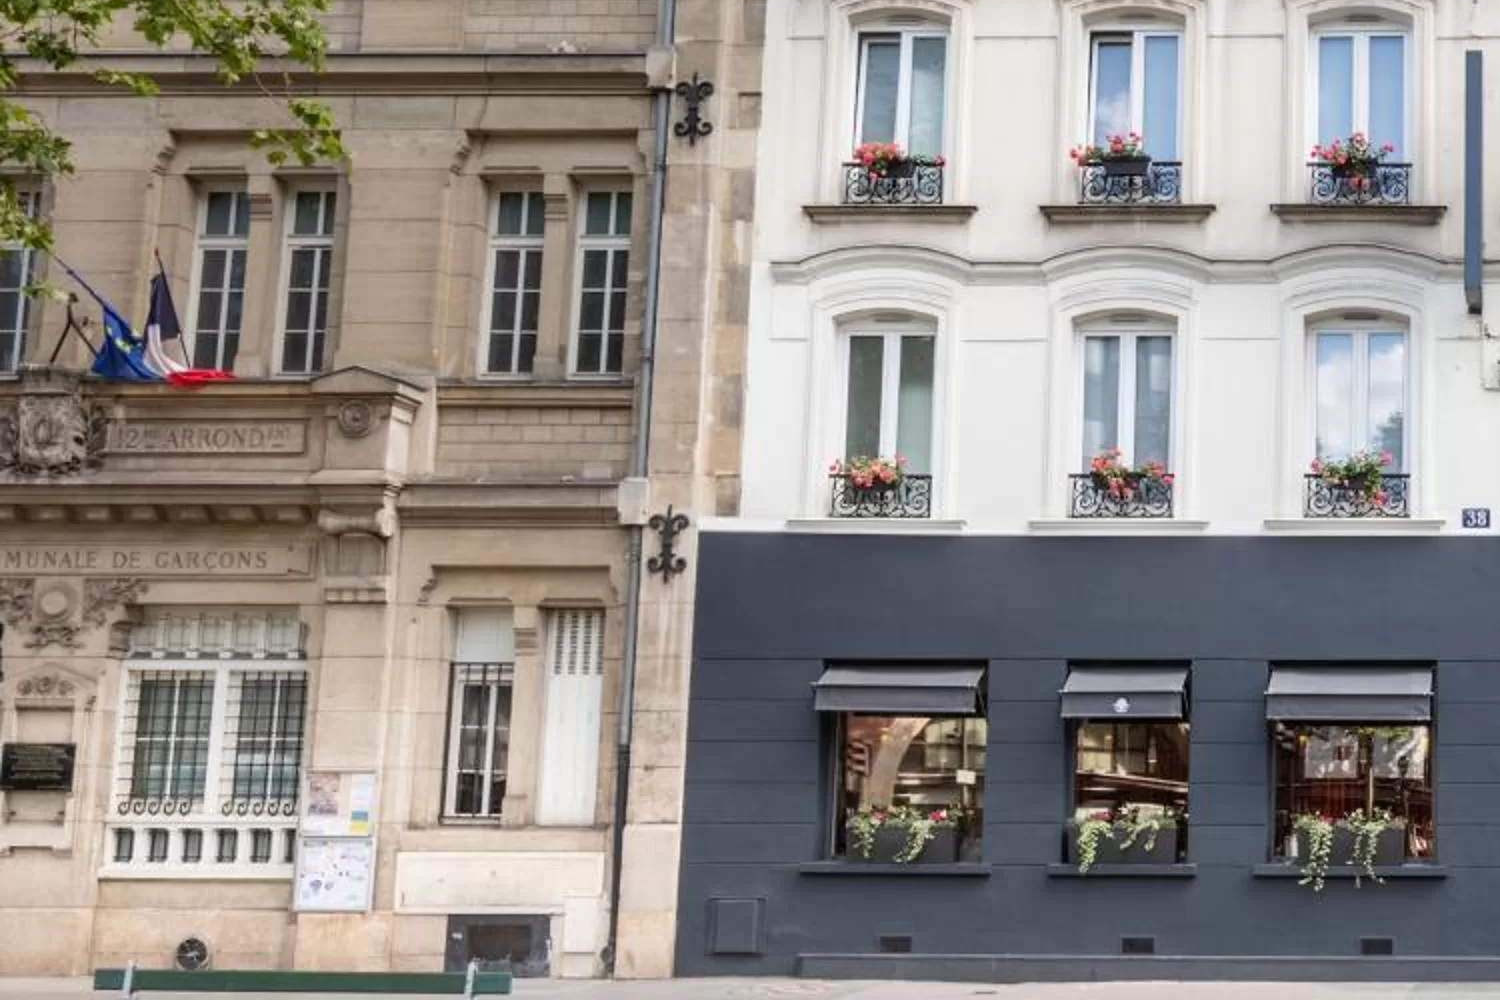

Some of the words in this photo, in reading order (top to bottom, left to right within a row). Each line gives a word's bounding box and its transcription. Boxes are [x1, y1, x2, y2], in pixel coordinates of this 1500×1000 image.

[1464, 510, 1488, 527] 38
[4, 551, 97, 569] MUNALE
[112, 551, 142, 569] DE
[154, 551, 268, 572] GARÇONS
